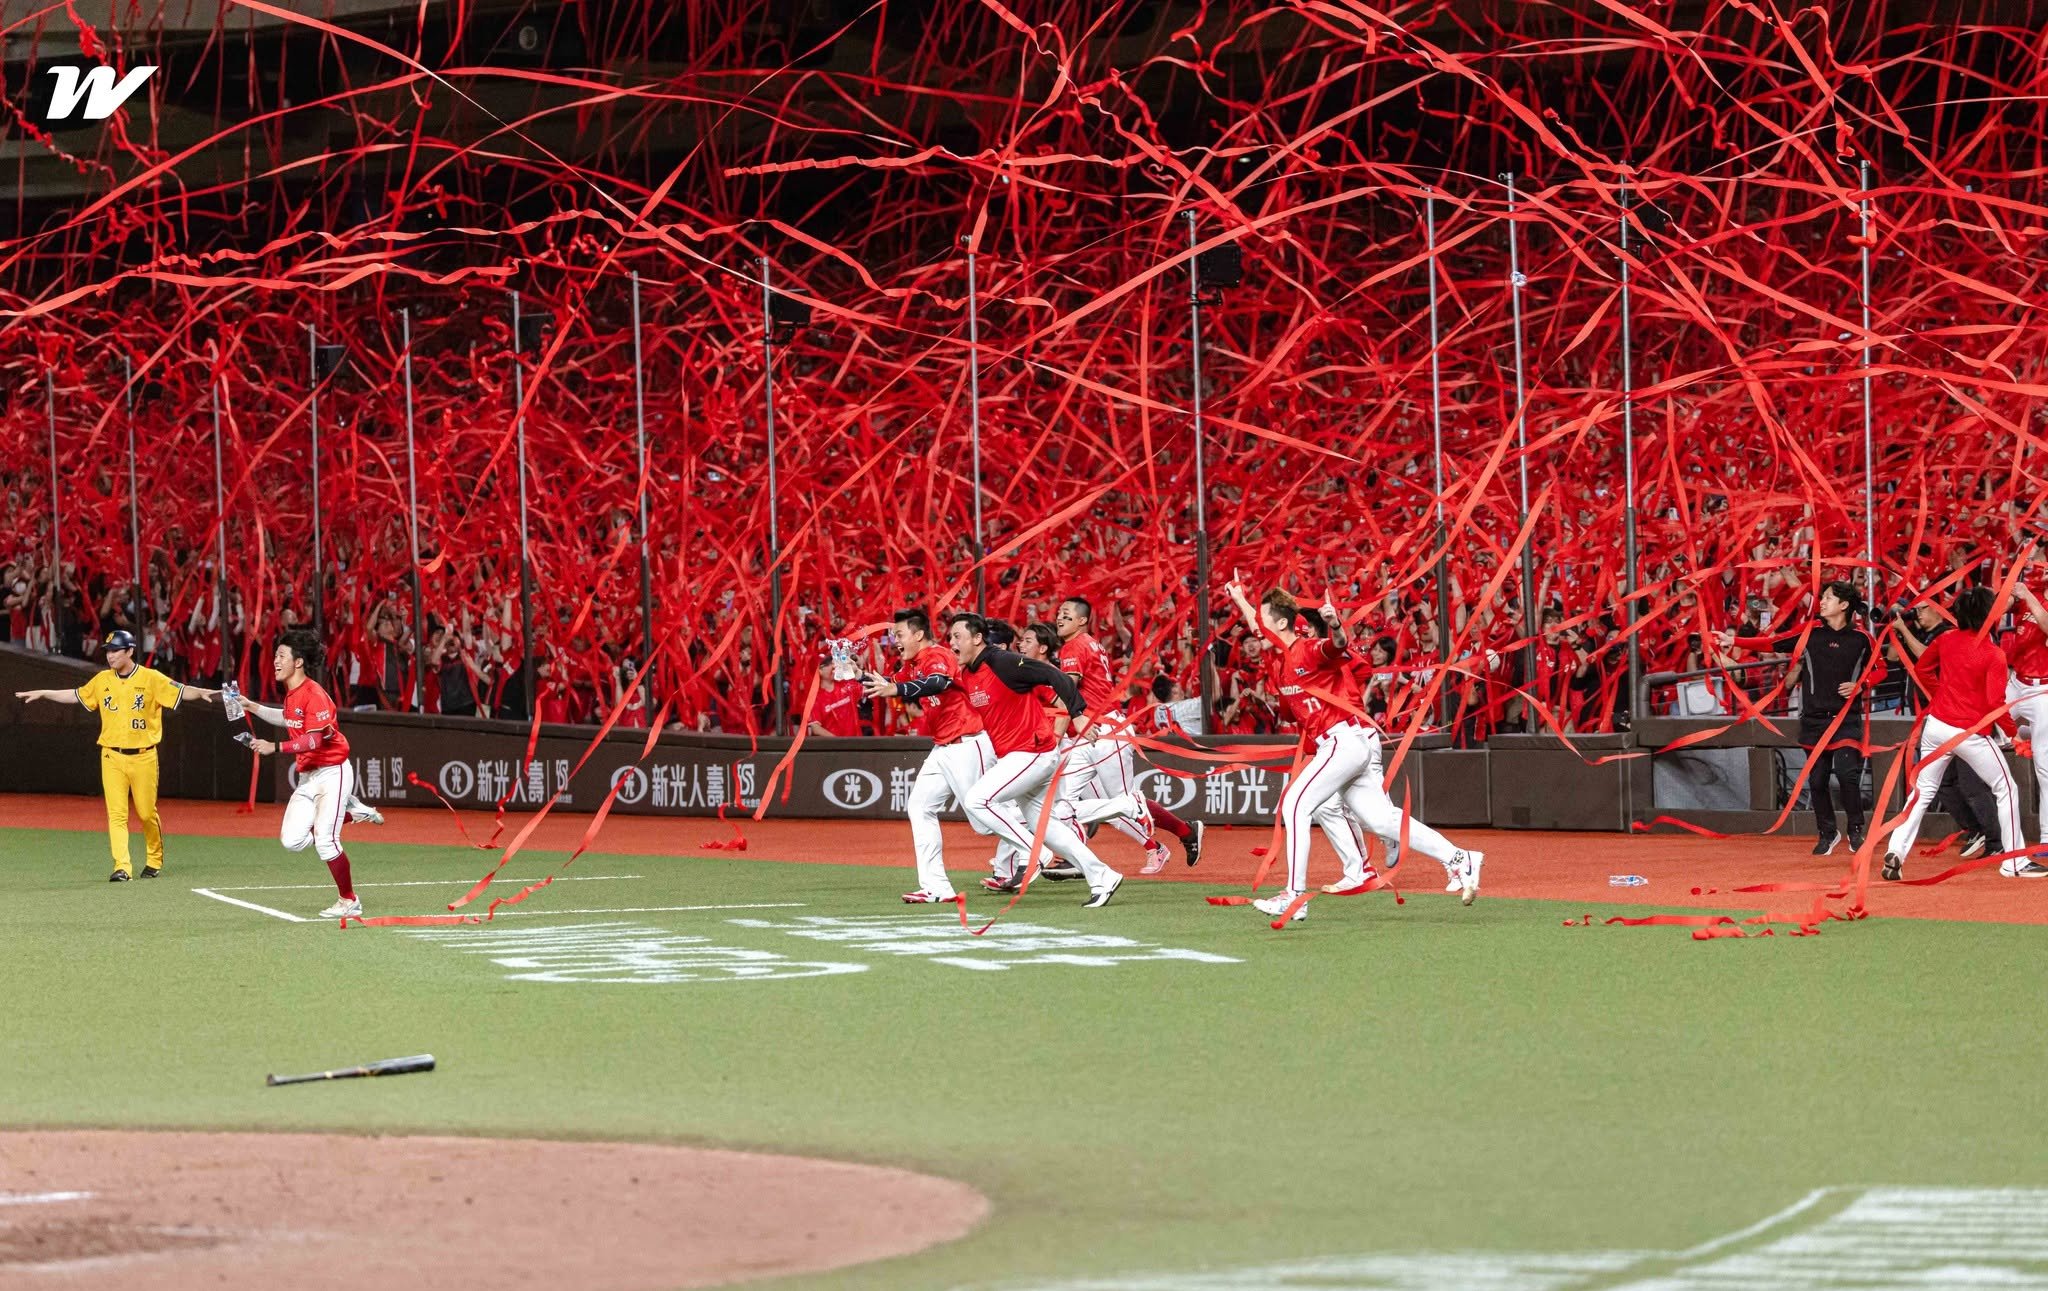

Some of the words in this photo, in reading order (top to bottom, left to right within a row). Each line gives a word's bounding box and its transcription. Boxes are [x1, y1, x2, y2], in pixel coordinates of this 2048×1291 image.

[104, 695, 145, 711] 兄弟
[132, 719, 147, 729] 63
[352, 757, 381, 798] 人壽
[477, 760, 544, 803] 新光人壽
[652, 764, 725, 807] 新光人壽
[1205, 766, 1288, 814] 新光
